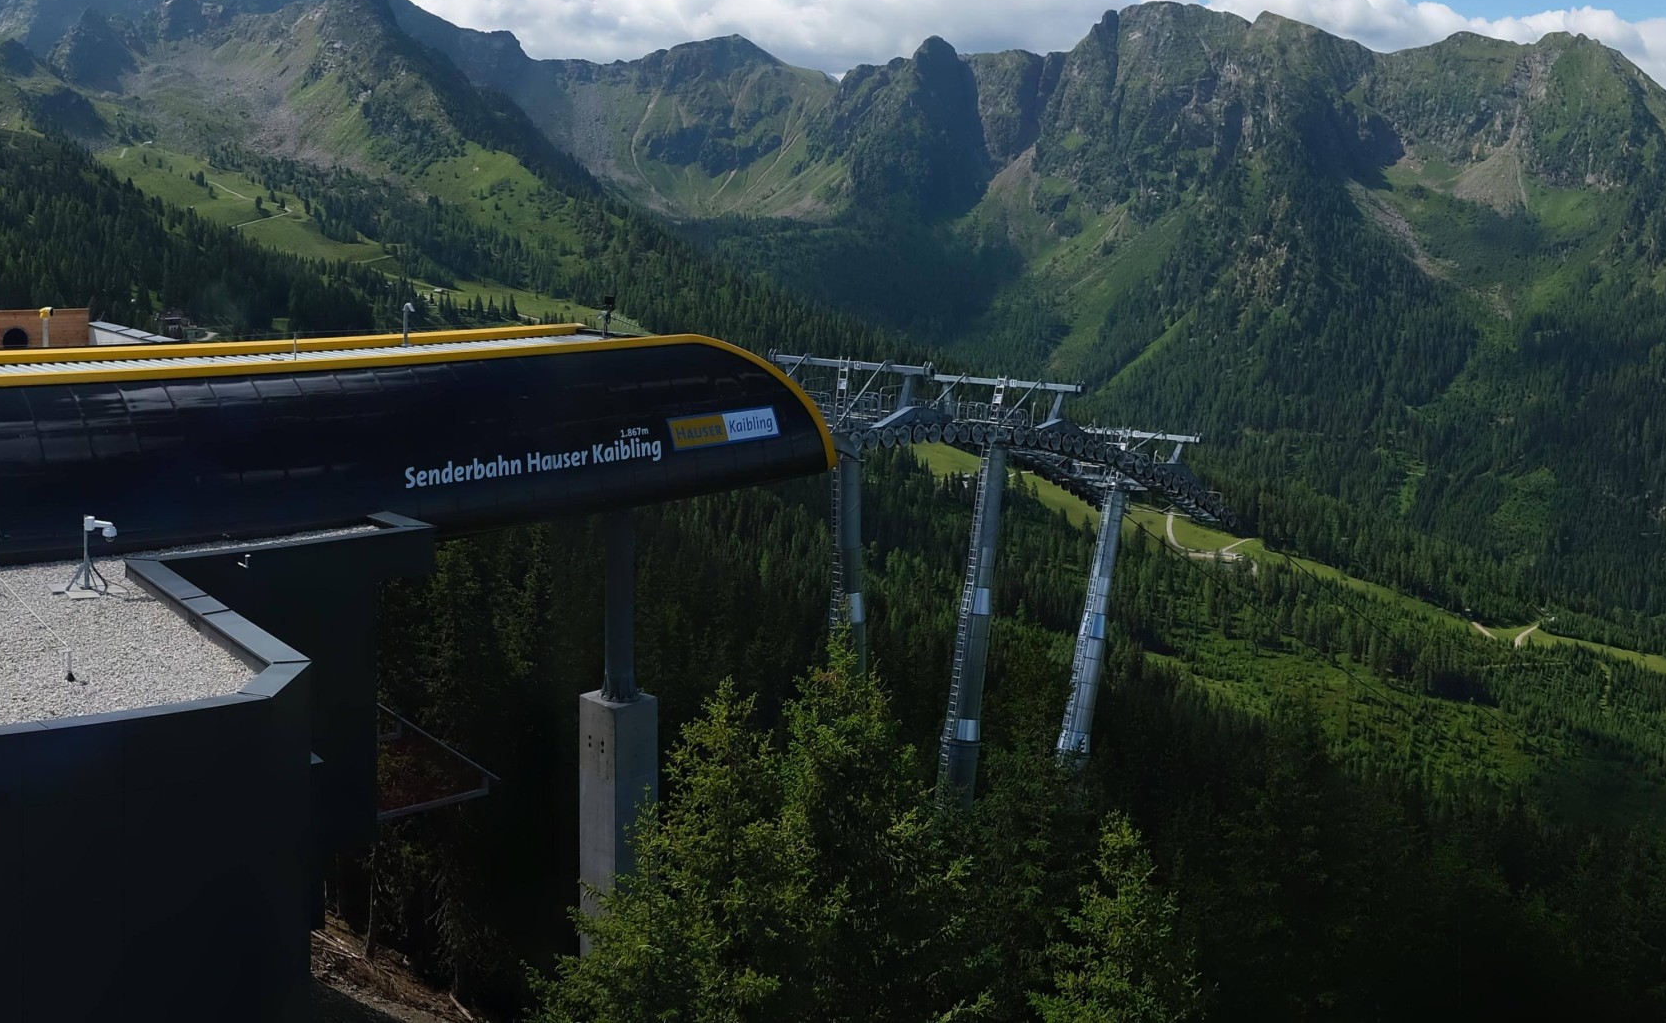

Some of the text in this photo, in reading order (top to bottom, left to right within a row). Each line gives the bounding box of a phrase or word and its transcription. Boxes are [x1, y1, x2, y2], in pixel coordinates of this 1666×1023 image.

[620, 426, 650, 438] 1.867m
[675, 415, 774, 442] HAUSER Kaibling
[404, 437, 663, 489] Senderbahn Hauser Kaibling
